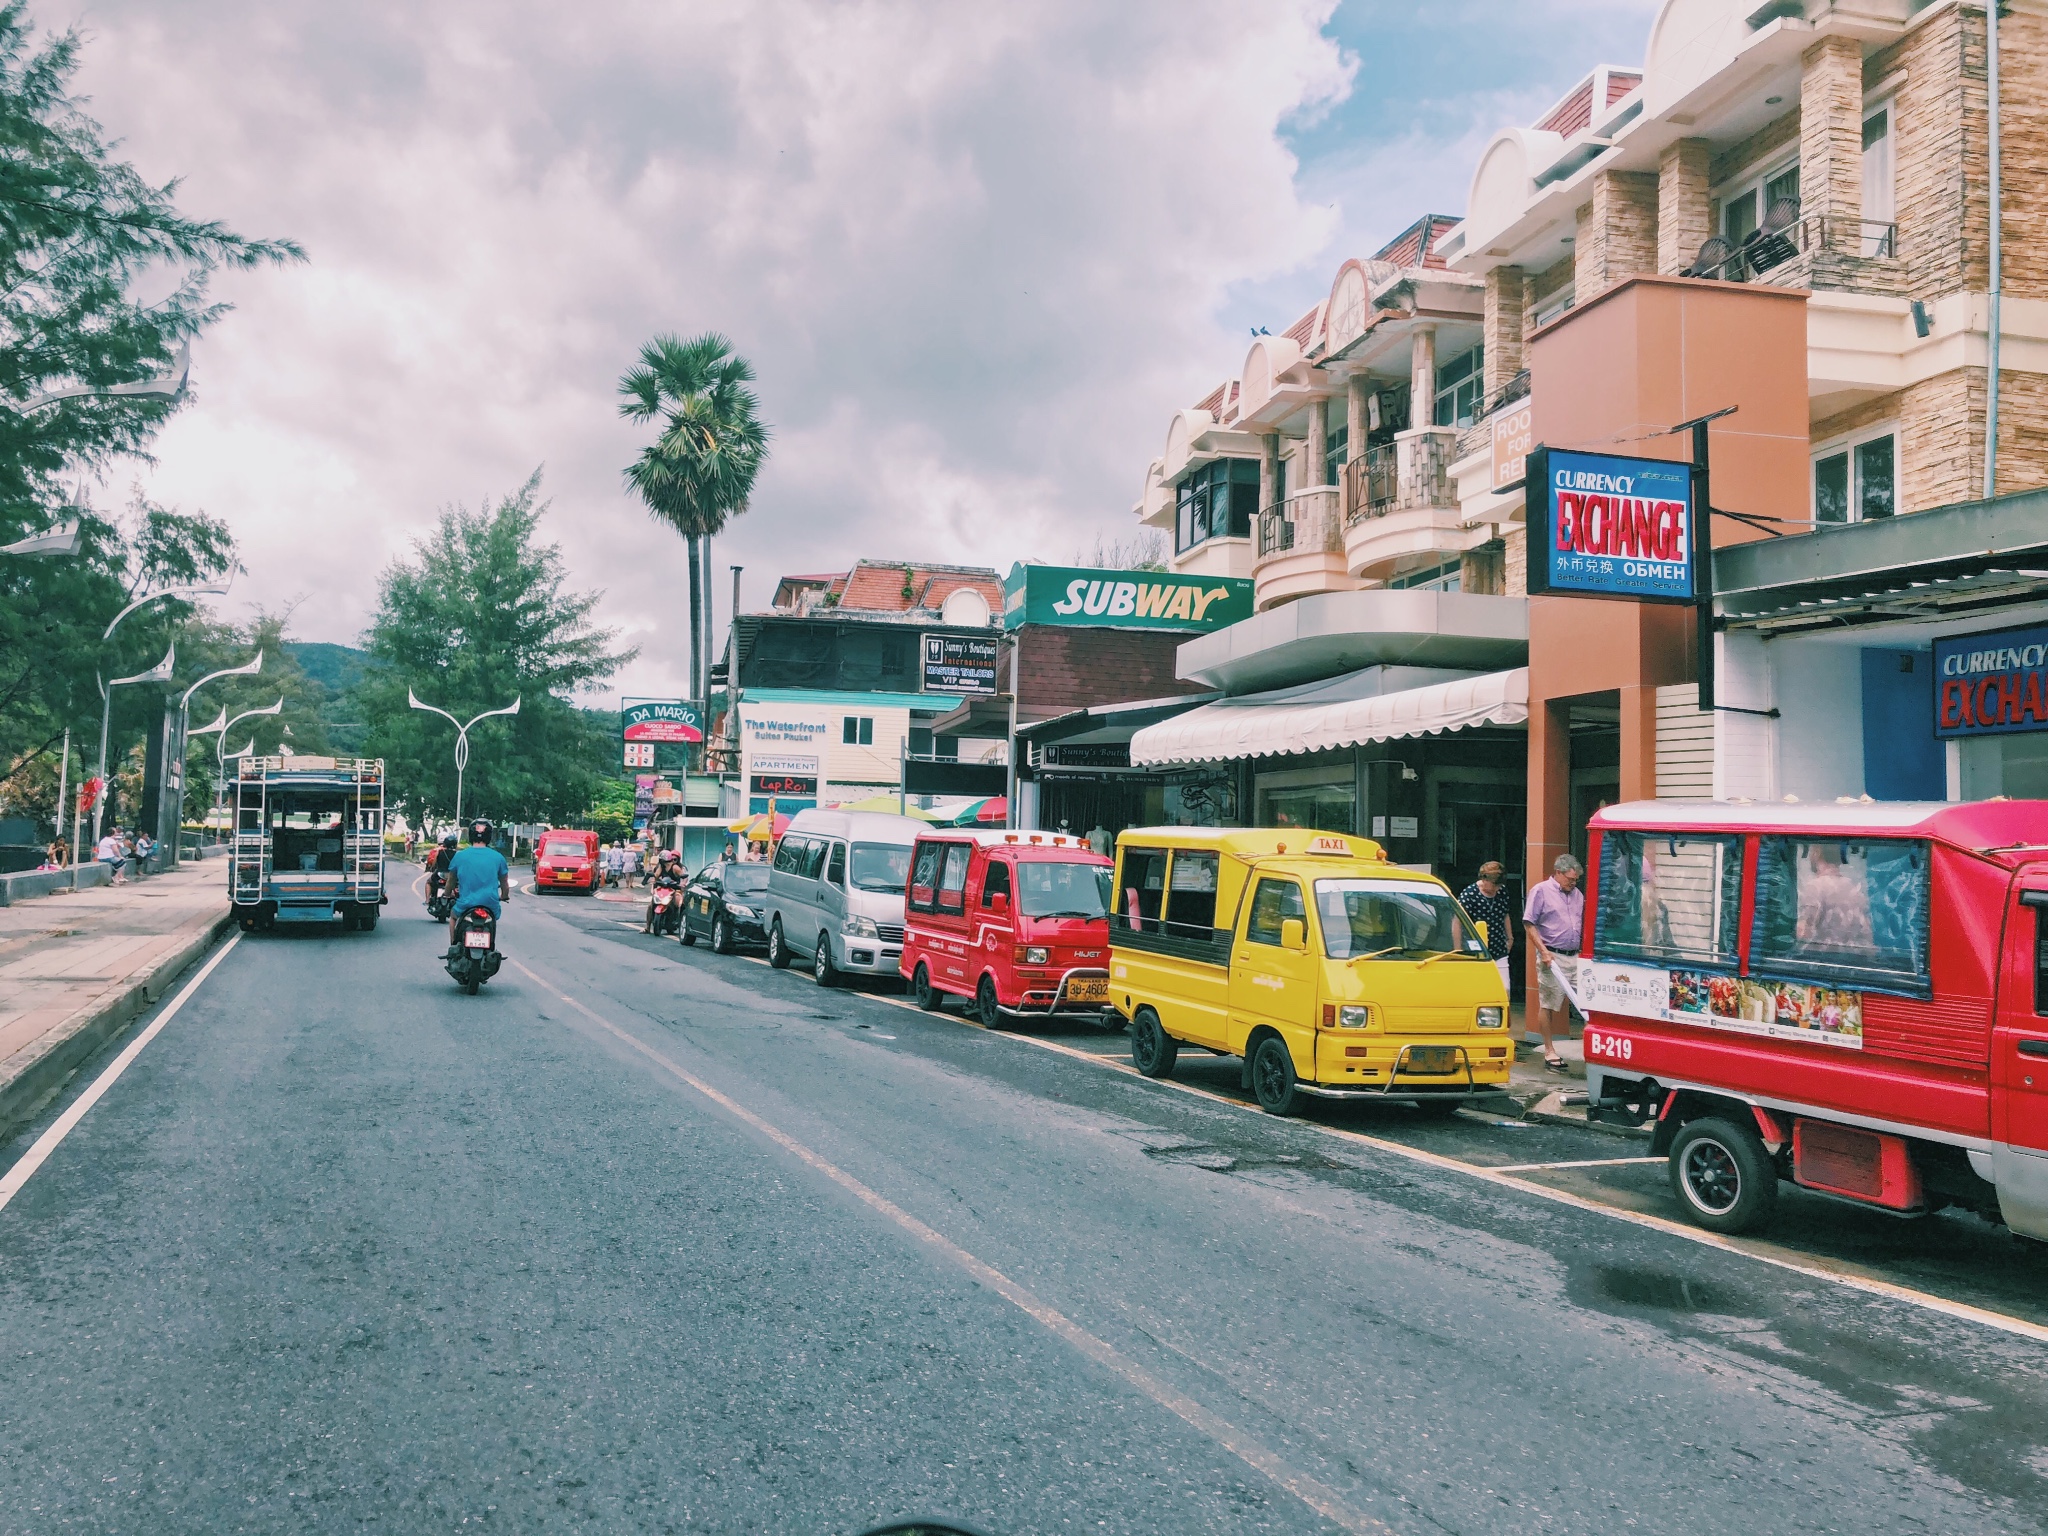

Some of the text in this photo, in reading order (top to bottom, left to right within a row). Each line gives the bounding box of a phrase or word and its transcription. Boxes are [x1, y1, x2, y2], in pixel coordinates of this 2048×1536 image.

[1508, 432, 1531, 455] FOR
[1556, 469, 1635, 493] CURRENCY
[1556, 491, 1684, 561] EXCHANGE
[1557, 557, 1614, 574] 外币兑换
[1623, 562, 1685, 580] ОБМЕН
[1558, 574, 1685, 590] Better Rate Greater Service
[1053, 579, 1229, 621] SUBWAY
[944, 641, 995, 659] Sunny's Boutiques
[944, 655, 996, 667] International
[1943, 643, 2048, 676] CURRENCY
[926, 666, 994, 678] MASTER TAILORS
[942, 676, 957, 684] VIP
[1940, 671, 2048, 729] EXCHA
[630, 706, 696, 724] DA MARIO
[745, 720, 826, 733] The Waterfront
[755, 732, 813, 741] Suites Phuket
[1061, 747, 1130, 759] Sunny's Boutiq
[753, 761, 816, 770] APARTMENT
[760, 775, 782, 793] Lap
[1319, 838, 1344, 850] TAXI
[1073, 950, 1101, 958] HIJET
[1591, 1033, 1632, 1060] B-219
